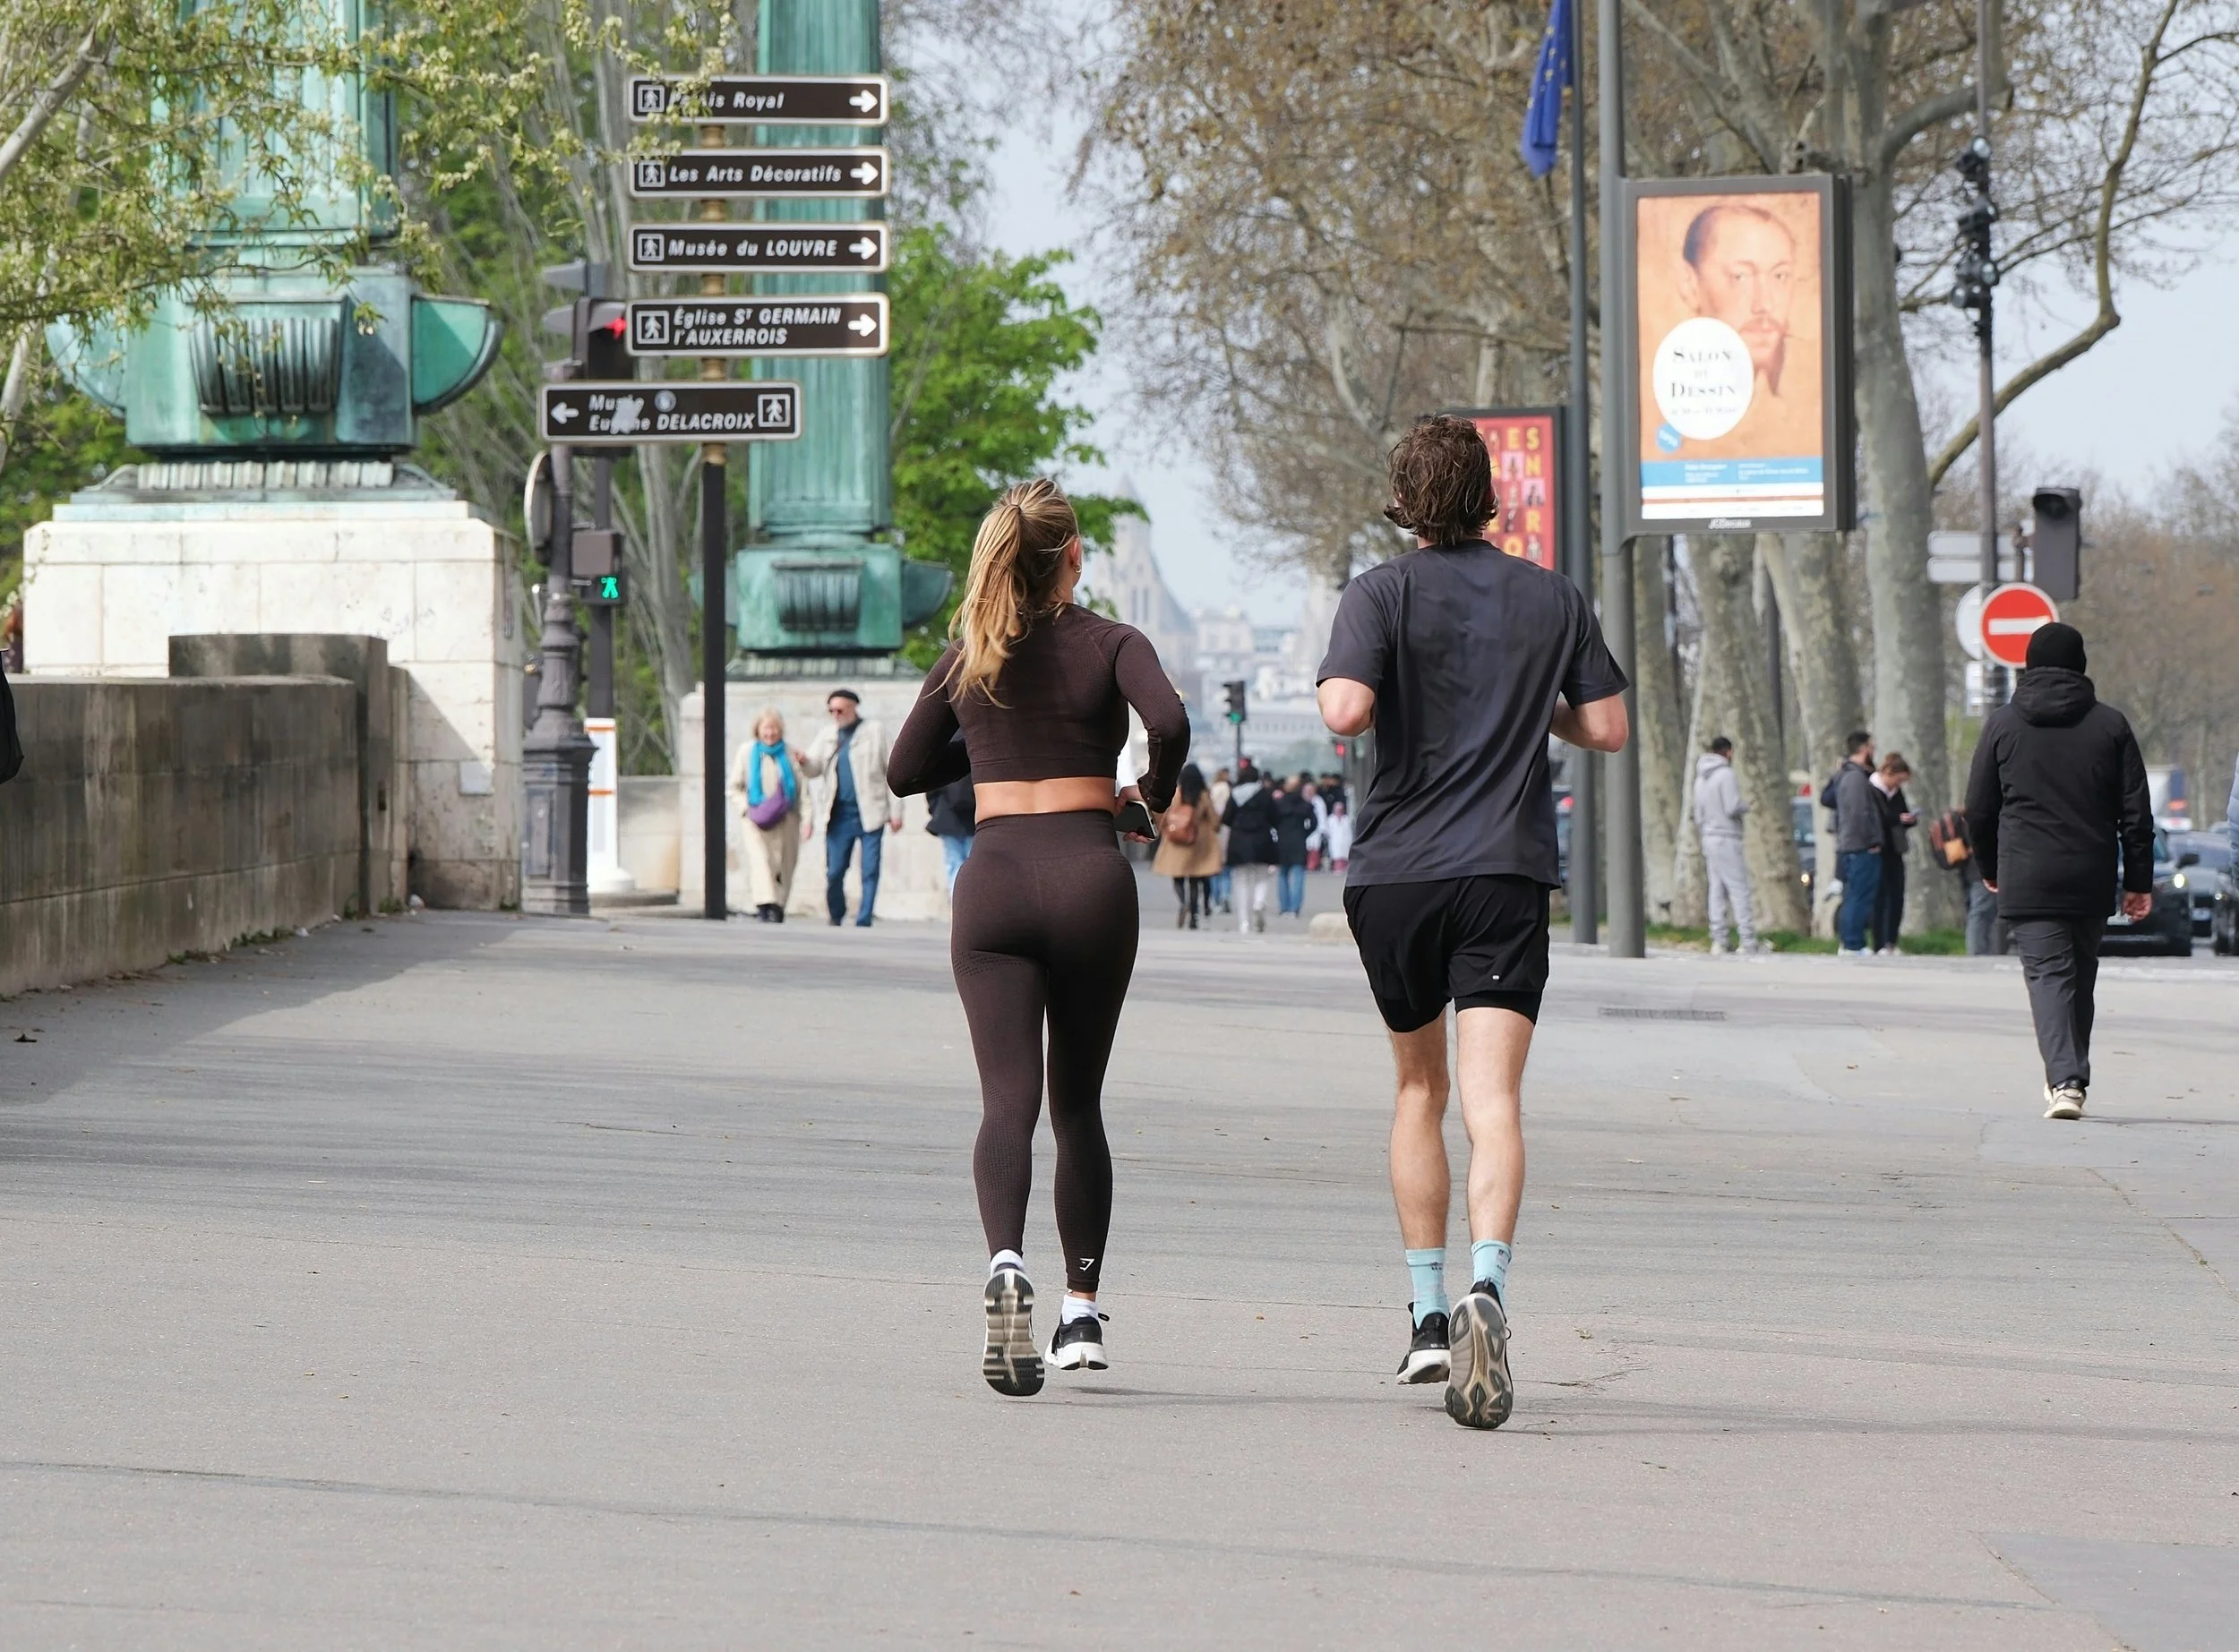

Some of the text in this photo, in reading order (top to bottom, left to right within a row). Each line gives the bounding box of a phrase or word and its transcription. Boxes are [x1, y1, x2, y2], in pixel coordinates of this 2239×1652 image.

[669, 91, 785, 112] Pais Royal
[669, 165, 842, 183] Les Arts Décoratifs
[668, 239, 838, 257] Musée du LOUVRE
[673, 305, 726, 329] Église
[759, 307, 842, 325] GERMAIN
[1673, 347, 1732, 364] SALON
[1671, 381, 1736, 398] DESSIN
[588, 394, 645, 412] Mue
[588, 413, 756, 434] Eune DELACROIX
